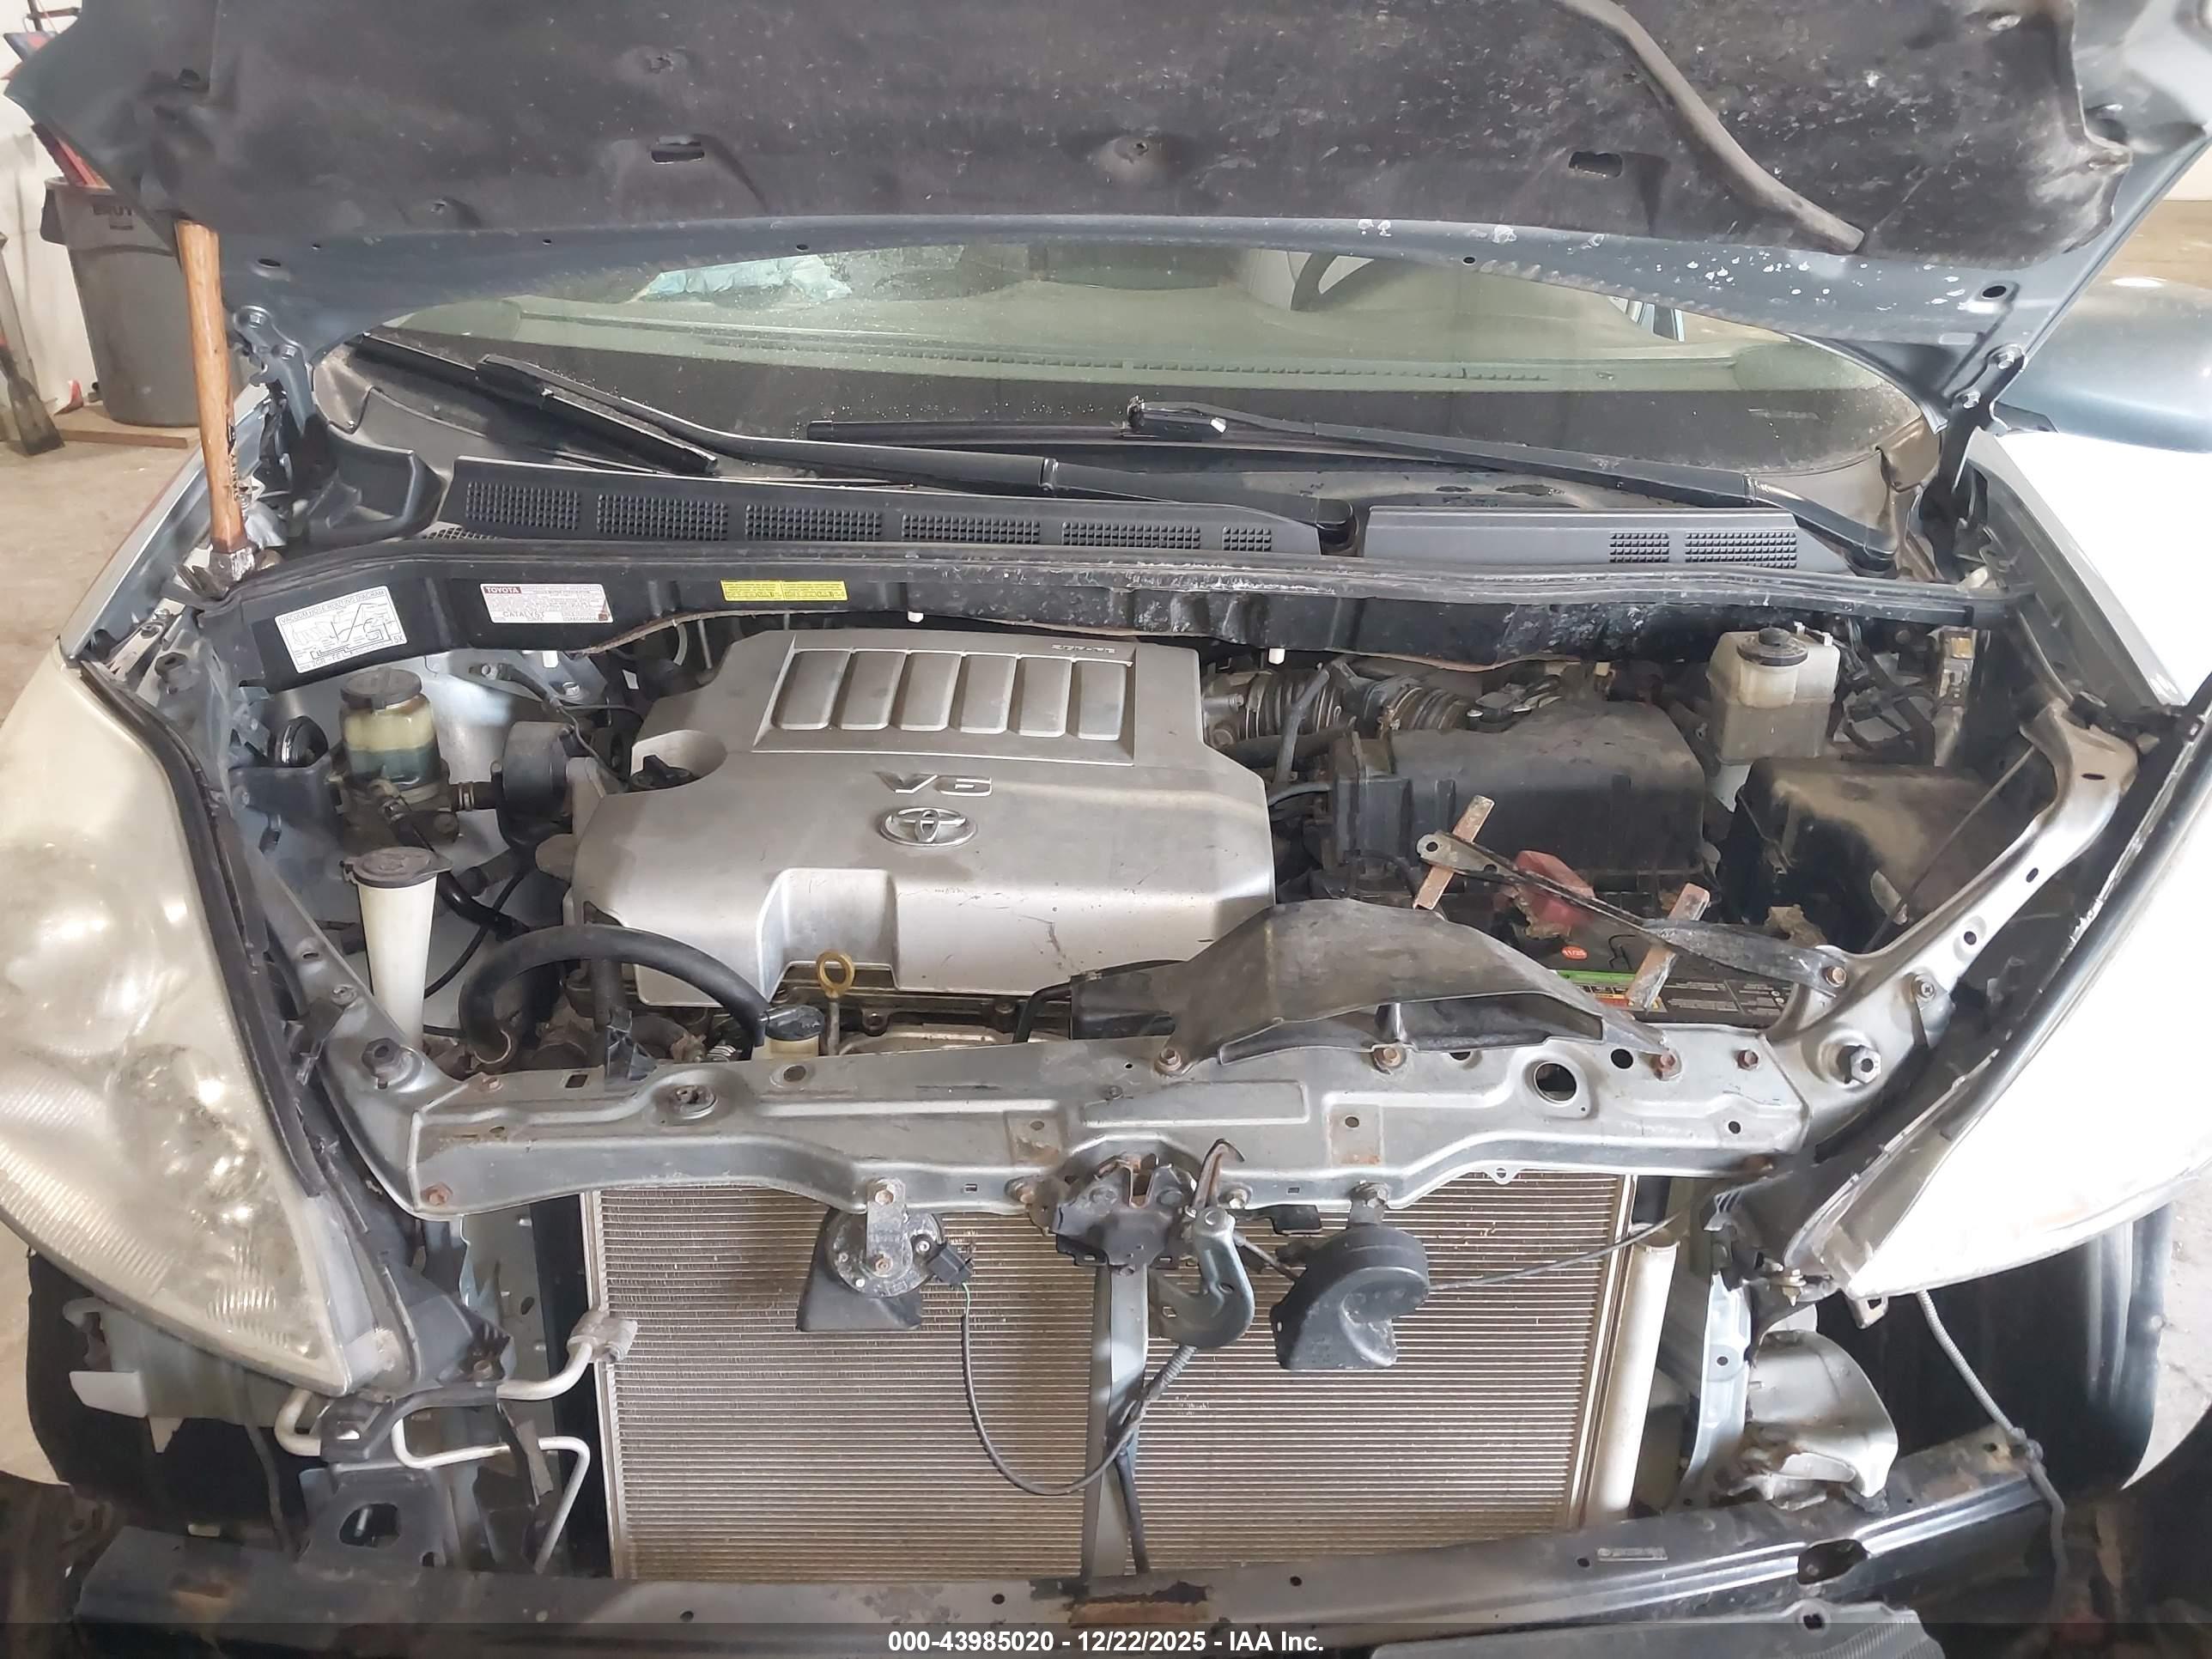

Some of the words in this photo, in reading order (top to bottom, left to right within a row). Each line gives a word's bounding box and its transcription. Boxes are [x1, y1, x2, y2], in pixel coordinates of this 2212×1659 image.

[281, 611, 308, 624] VACUUM
[309, 605, 326, 617] HOSE
[326, 598, 356, 611] ROUTING
[356, 590, 386, 603] DIAGRAM
[393, 635, 404, 644] 5X
[873, 771, 993, 797] V6
